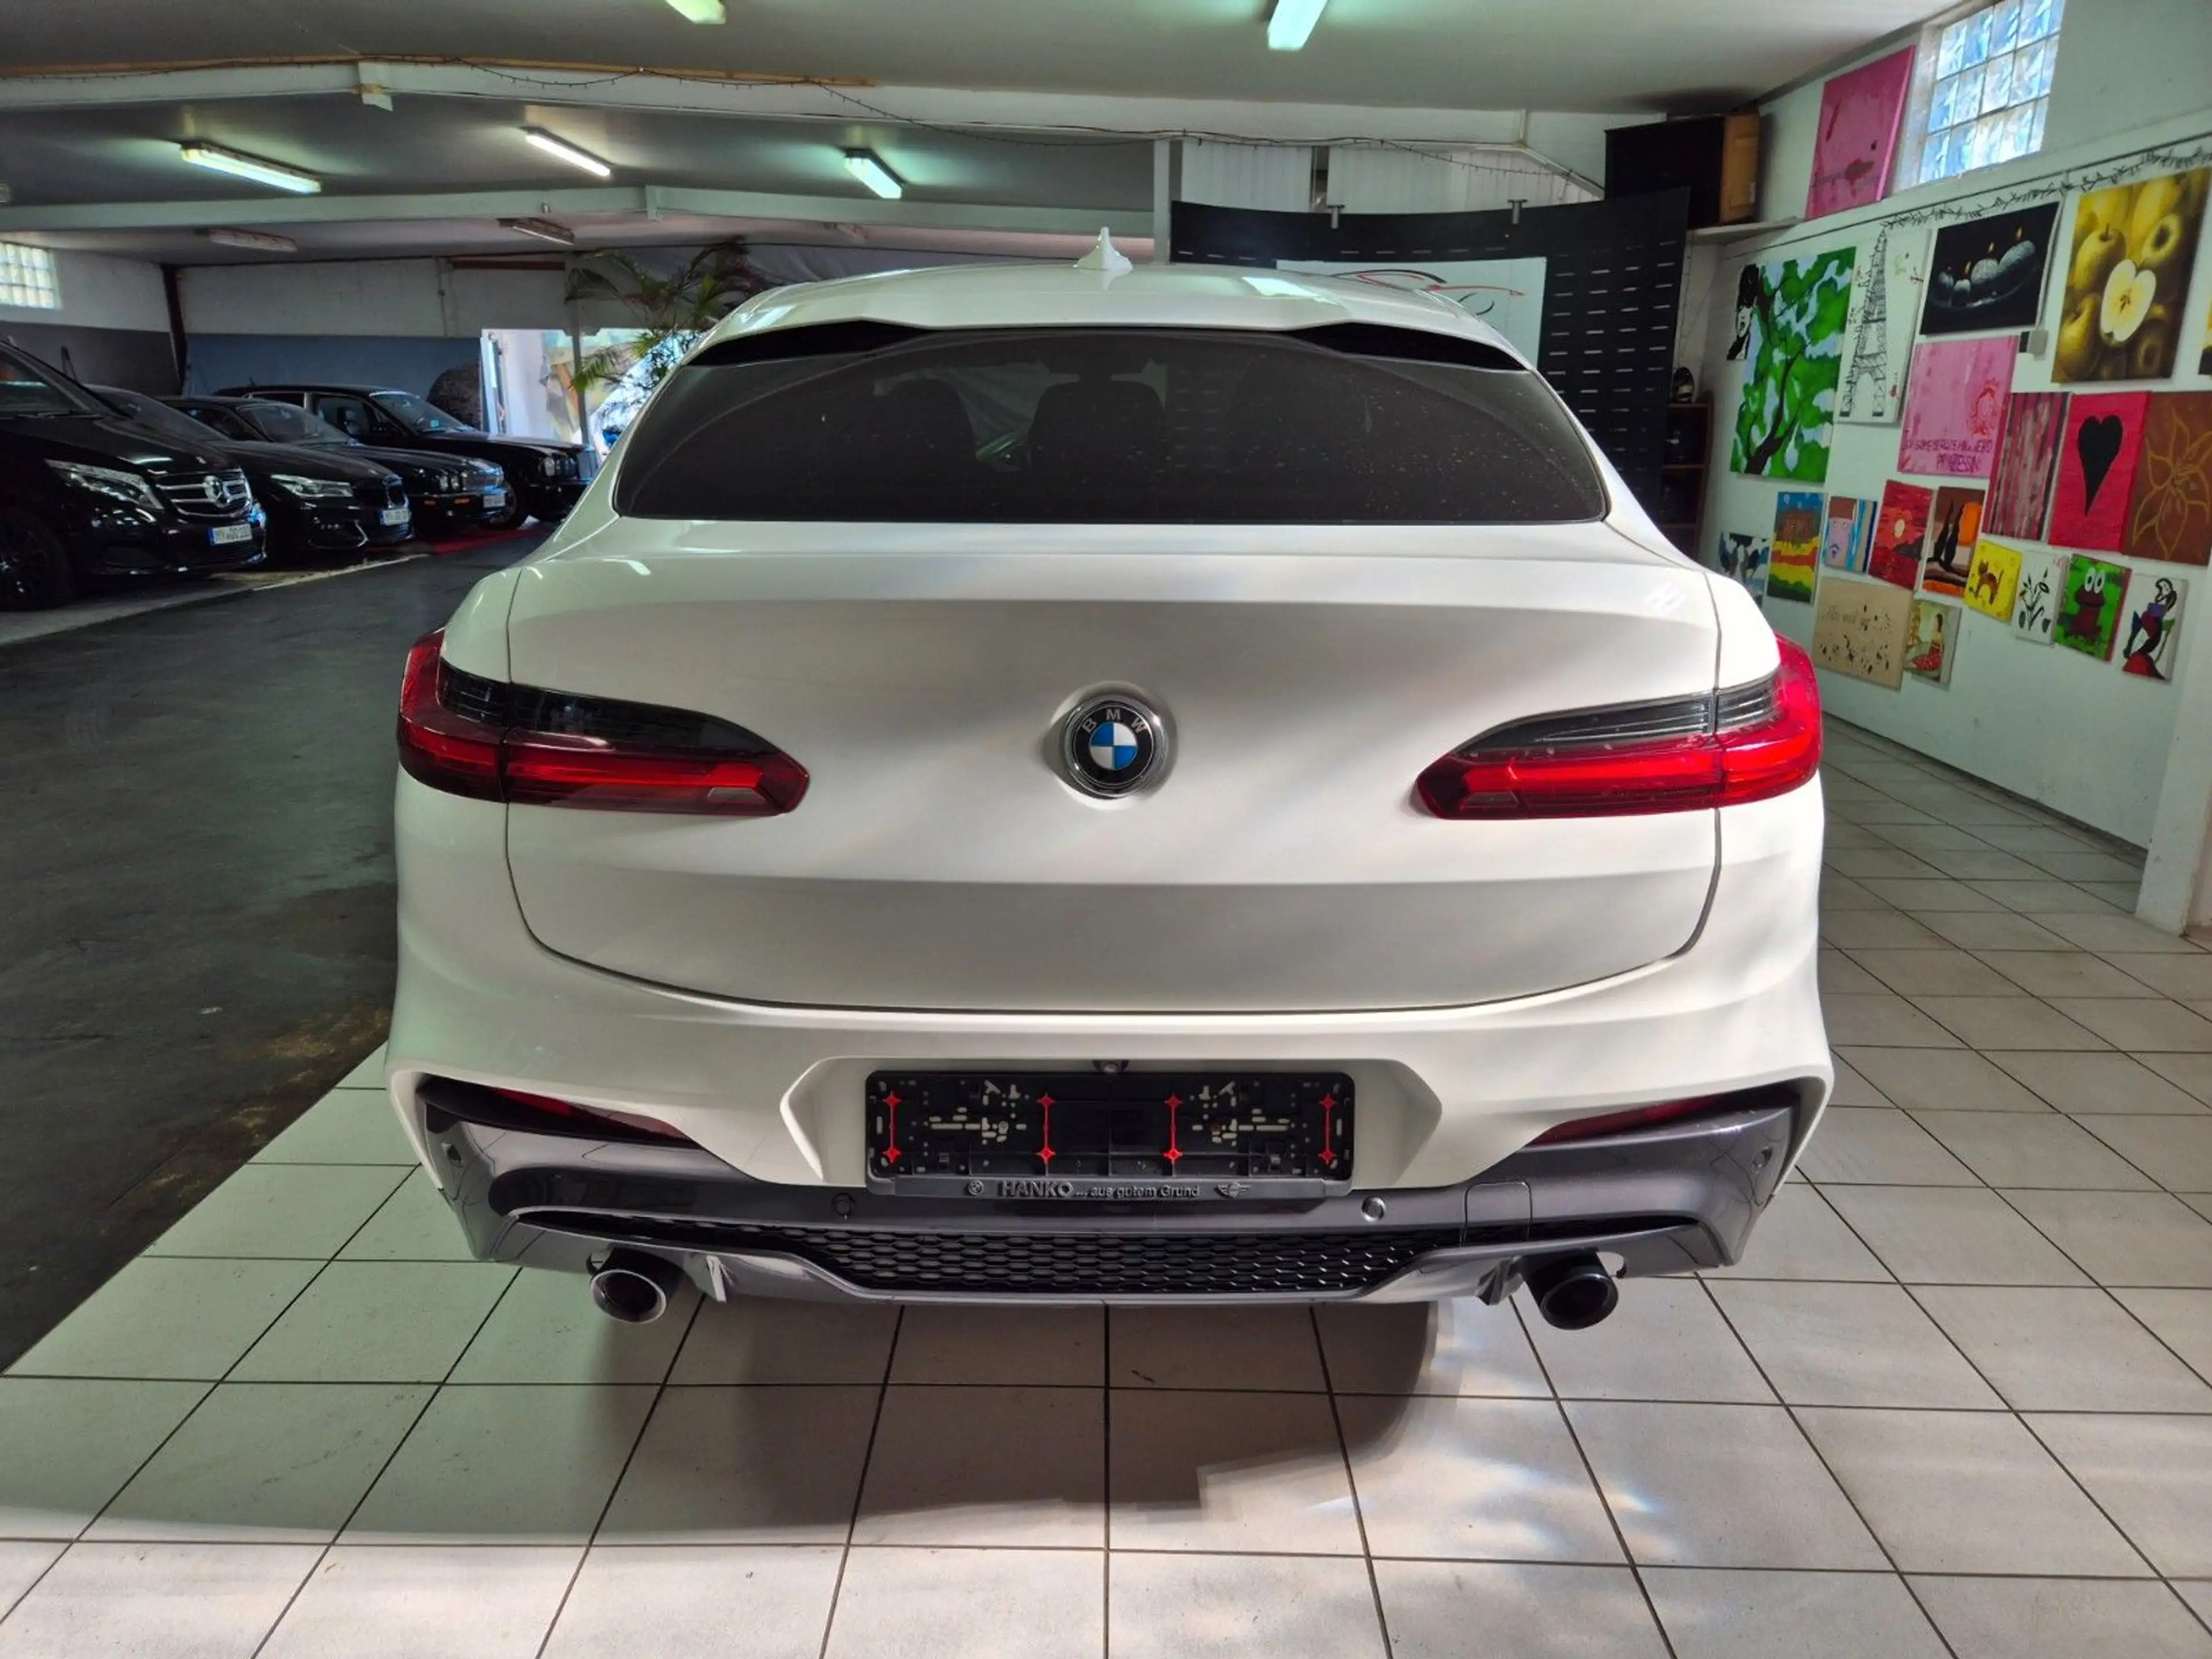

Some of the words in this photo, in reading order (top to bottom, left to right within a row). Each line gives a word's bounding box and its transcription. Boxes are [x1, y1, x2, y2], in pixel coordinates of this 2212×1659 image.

[1082, 709, 1147, 734] BMW
[1002, 1180, 1074, 1197] HANKO
[1160, 1184, 1200, 1198] Grund
